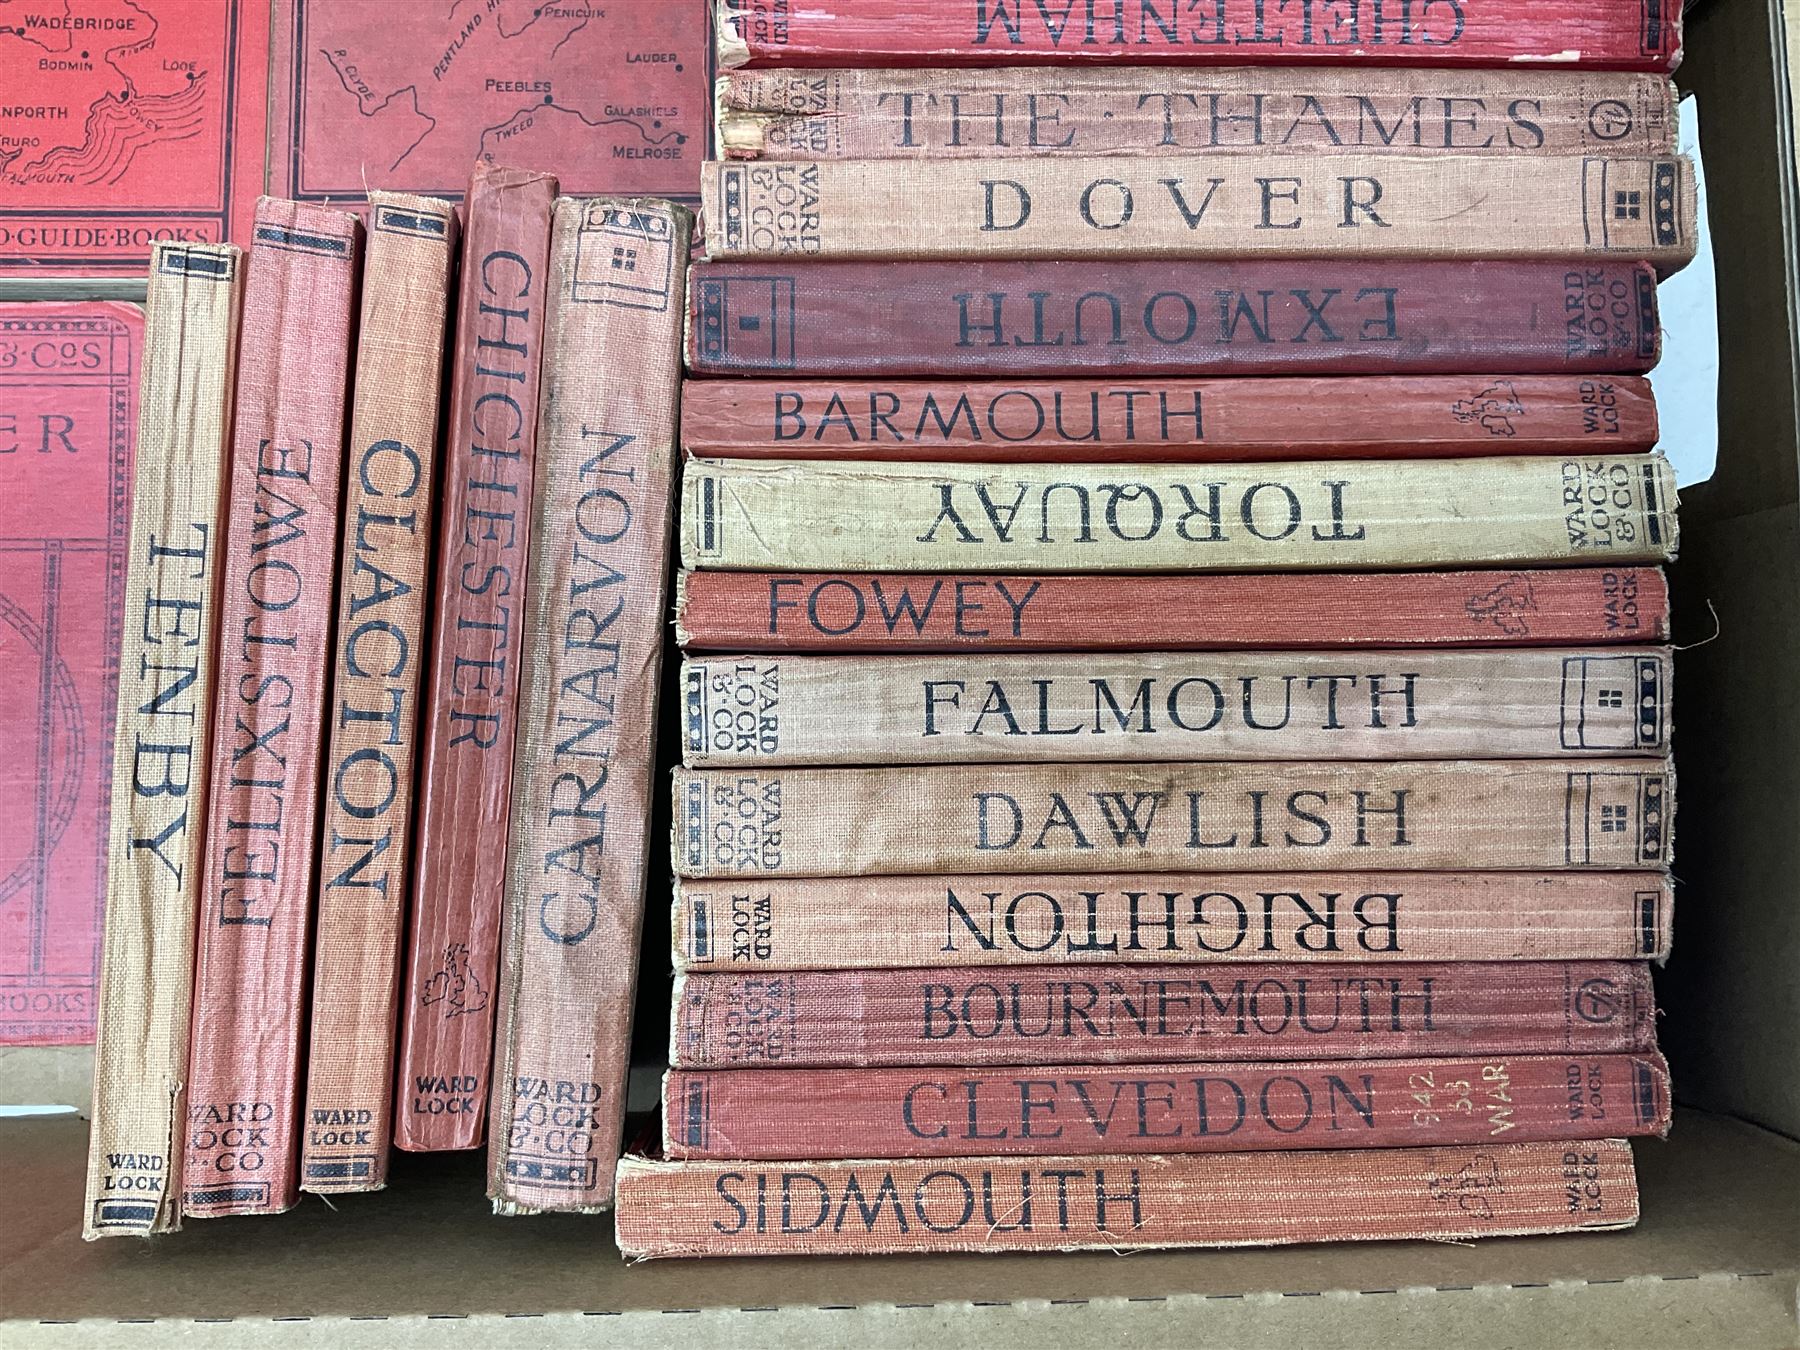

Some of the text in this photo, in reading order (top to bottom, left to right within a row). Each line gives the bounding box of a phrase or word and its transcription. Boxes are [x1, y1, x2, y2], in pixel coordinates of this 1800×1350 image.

[24, 14, 136, 31] WADEBRIDGE
[544, 8, 606, 19] PENICUIK
[972, 0, 1465, 46] CHELTENHAM
[39, 58, 93, 71] BODMIN
[163, 59, 197, 71] LOOE
[433, 14, 482, 81] PENTLAND
[626, 52, 677, 63] LAUDER
[345, 65, 377, 101] CLYDE
[485, 79, 552, 94] PEEBLES
[604, 105, 678, 117] GALASHIELS
[2, 106, 68, 118] NPORTH
[495, 118, 534, 143] TWEED
[789, 79, 809, 152] LOCK
[810, 77, 829, 153] WARD
[877, 93, 1545, 149] THE THAMES
[612, 145, 682, 160] MELROSE
[752, 207, 775, 250] CO
[776, 165, 797, 255] LOCK
[799, 163, 820, 255] WARD
[979, 176, 1392, 231] DOVER
[953, 287, 1402, 347] EXMOUTH
[1565, 271, 1585, 360] WARD
[1586, 269, 1608, 358] LOCK
[1610, 279, 1630, 322] CO
[774, 391, 1203, 442] BARMOUTH
[1579, 381, 1600, 434] WARD
[1600, 383, 1620, 434] LOCK
[450, 252, 530, 751] CHICHESTER
[916, 481, 1366, 543] TORQUAY
[1561, 462, 1589, 551] WARD
[1586, 462, 1613, 547] LOCK
[1610, 464, 1633, 507] CO
[768, 579, 1041, 638] FOWEY
[1603, 573, 1619, 630] WARD
[1623, 573, 1638, 630] LOCK
[219, 439, 313, 929] FELIXSTOWE
[326, 440, 422, 899] CLACTON
[540, 426, 638, 947] CARNARVON
[127, 523, 208, 892] TENBY
[713, 708, 734, 751] CO
[735, 664, 756, 753] LOCK
[760, 665, 780, 754] WARD
[922, 673, 1420, 736] FALMOUTH
[714, 820, 735, 865] CO
[737, 778, 758, 871] LOCK
[762, 780, 782, 870] WARD
[972, 789, 1412, 851] DAWLISH
[732, 895, 750, 961] LOCK
[754, 894, 771, 960] WARD
[940, 887, 1405, 953] BRIGHTON
[922, 978, 1438, 1043] BOURNEMOUTH
[414, 1097, 474, 1114] LOCK
[416, 1076, 478, 1094] WARD
[513, 1077, 602, 1104] WARD
[902, 1074, 1377, 1140] CLEVEDON
[1482, 1064, 1515, 1135] WAR
[1567, 1064, 1584, 1121] WARD
[1588, 1064, 1606, 1120] LOCK
[187, 1128, 270, 1150] OCK
[310, 1130, 370, 1146] LOCK
[311, 1109, 372, 1125] WARD
[545, 1130, 593, 1154] CO
[104, 1175, 162, 1191] LOCK
[107, 1154, 163, 1171] WARD
[1563, 1152, 1580, 1213] WARD
[1583, 1152, 1602, 1212] LOCK
[713, 1169, 1142, 1236] SIDMOUTH
